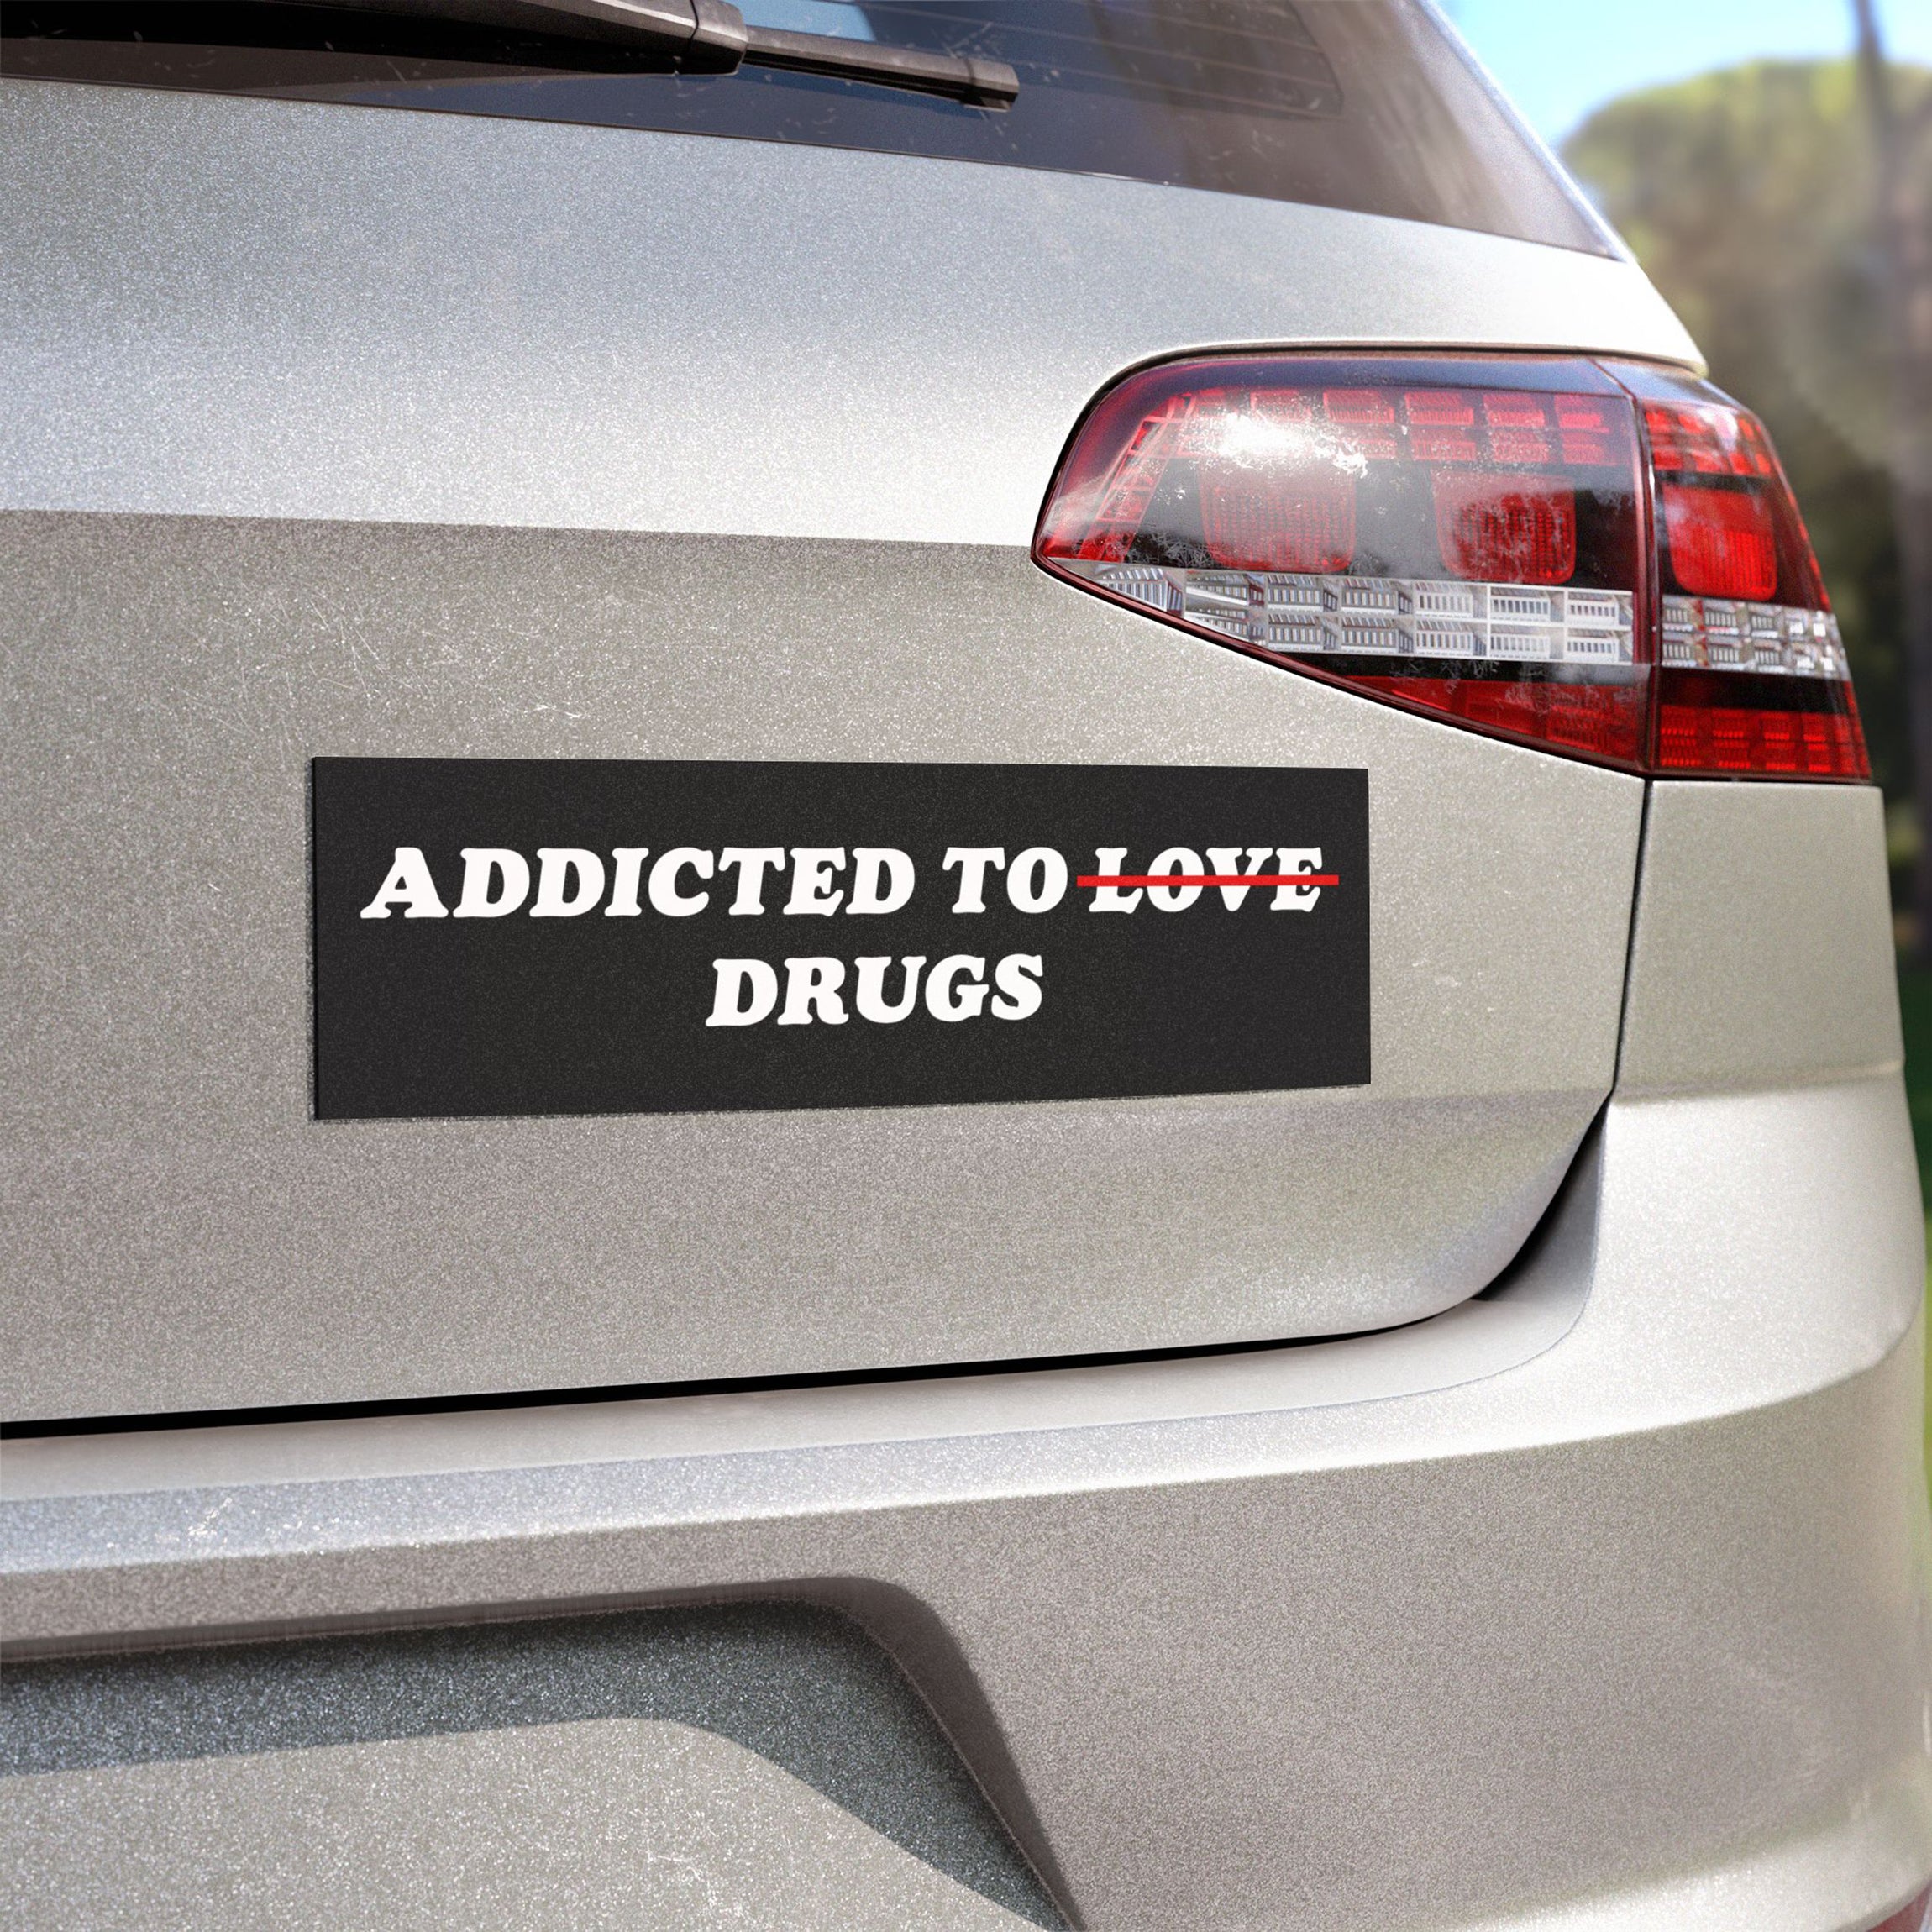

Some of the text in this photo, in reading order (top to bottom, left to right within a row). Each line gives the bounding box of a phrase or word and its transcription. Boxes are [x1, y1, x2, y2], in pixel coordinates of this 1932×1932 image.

[360, 847, 1323, 919] ADDICTED TO LOVE
[706, 954, 1043, 1027] DRUGS
